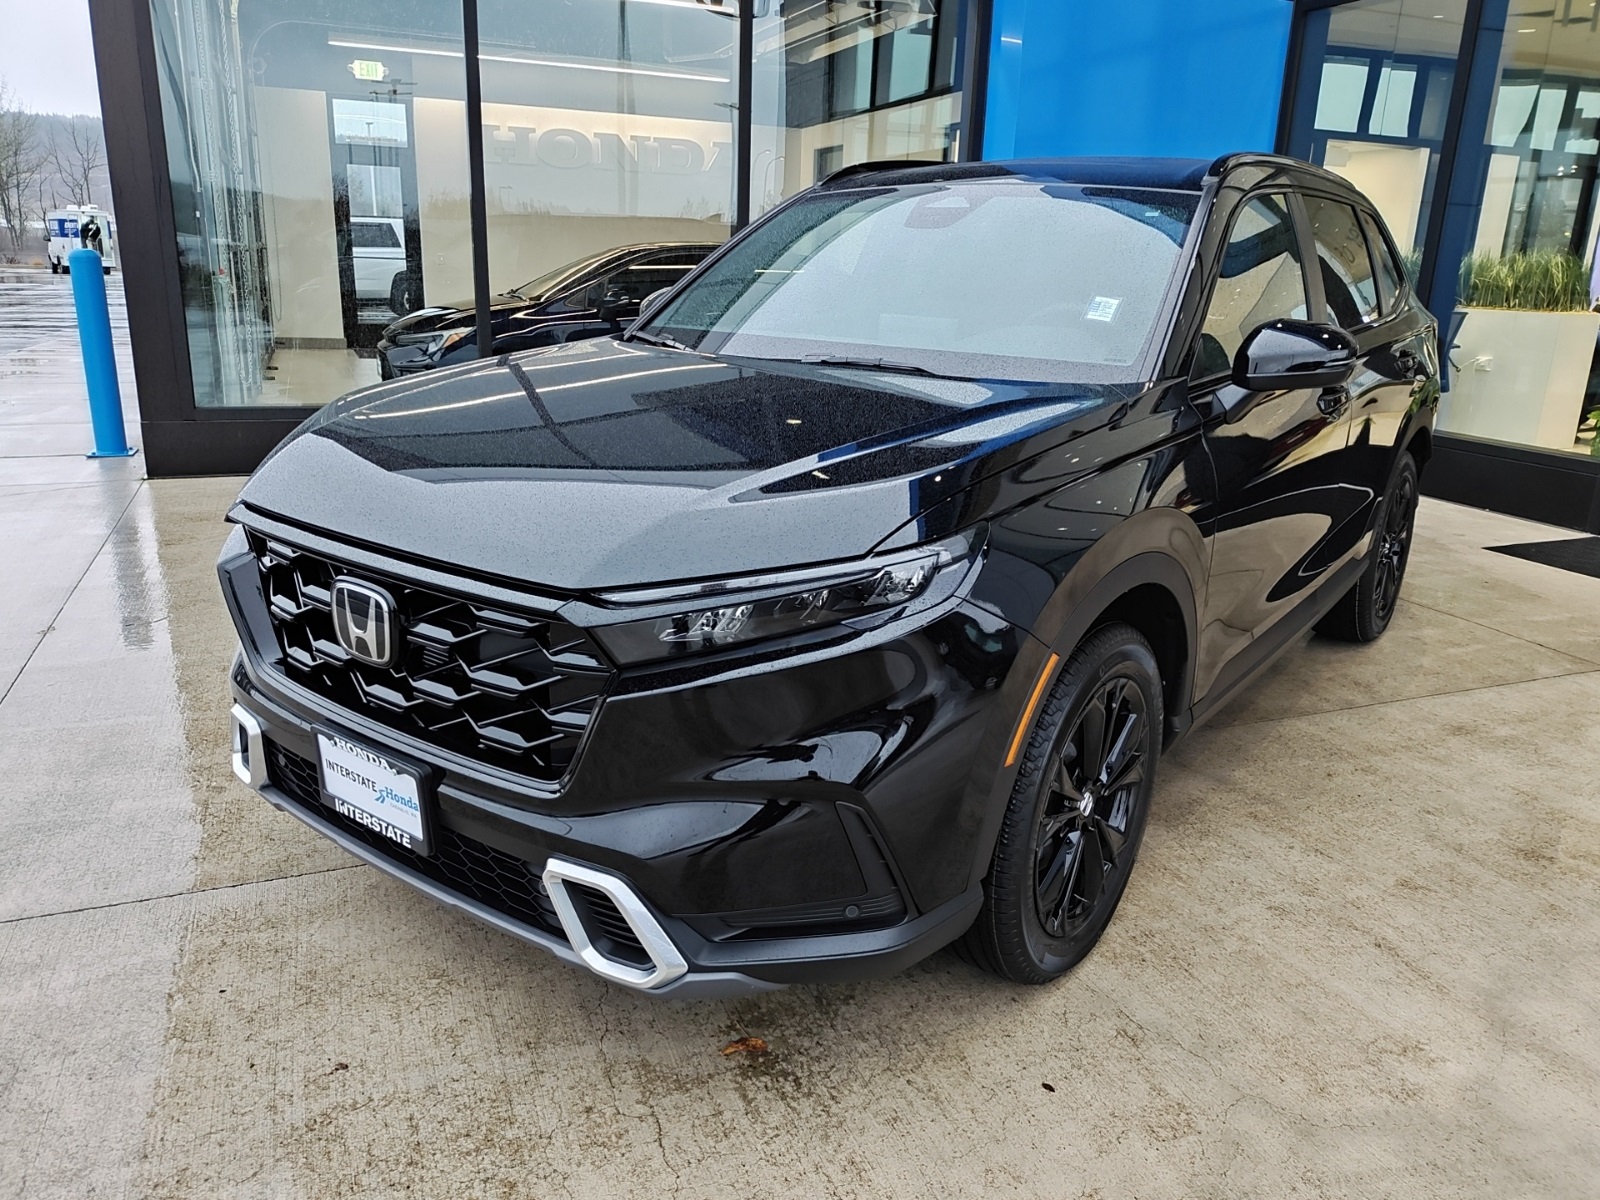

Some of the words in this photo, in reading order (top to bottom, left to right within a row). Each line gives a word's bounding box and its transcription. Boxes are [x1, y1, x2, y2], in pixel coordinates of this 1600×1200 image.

[359, 62, 379, 78] EXIT
[333, 736, 392, 770] HONDA
[325, 758, 378, 793] INTERSTATE
[384, 786, 419, 812] Honda
[334, 798, 412, 849] INTERSTATE
